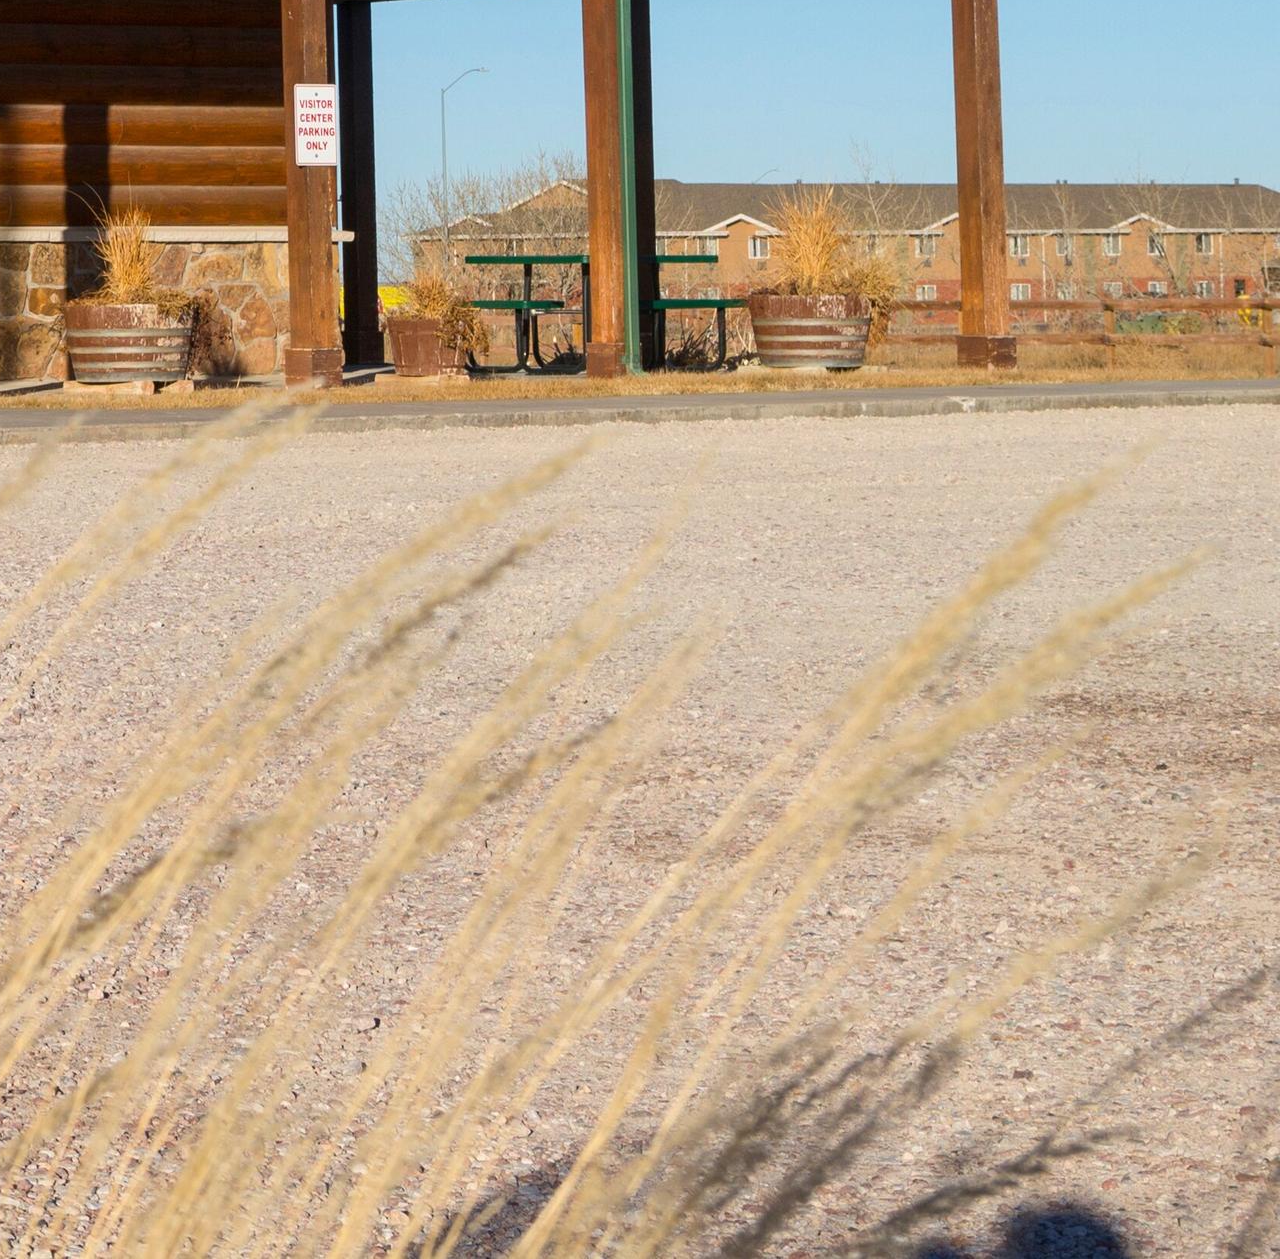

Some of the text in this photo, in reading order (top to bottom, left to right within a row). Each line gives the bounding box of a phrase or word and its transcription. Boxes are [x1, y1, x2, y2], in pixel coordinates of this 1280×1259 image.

[299, 99, 333, 108] VISITOR
[300, 113, 333, 122] CENTER
[298, 127, 335, 136] PARKING
[306, 141, 328, 150] ONLY
